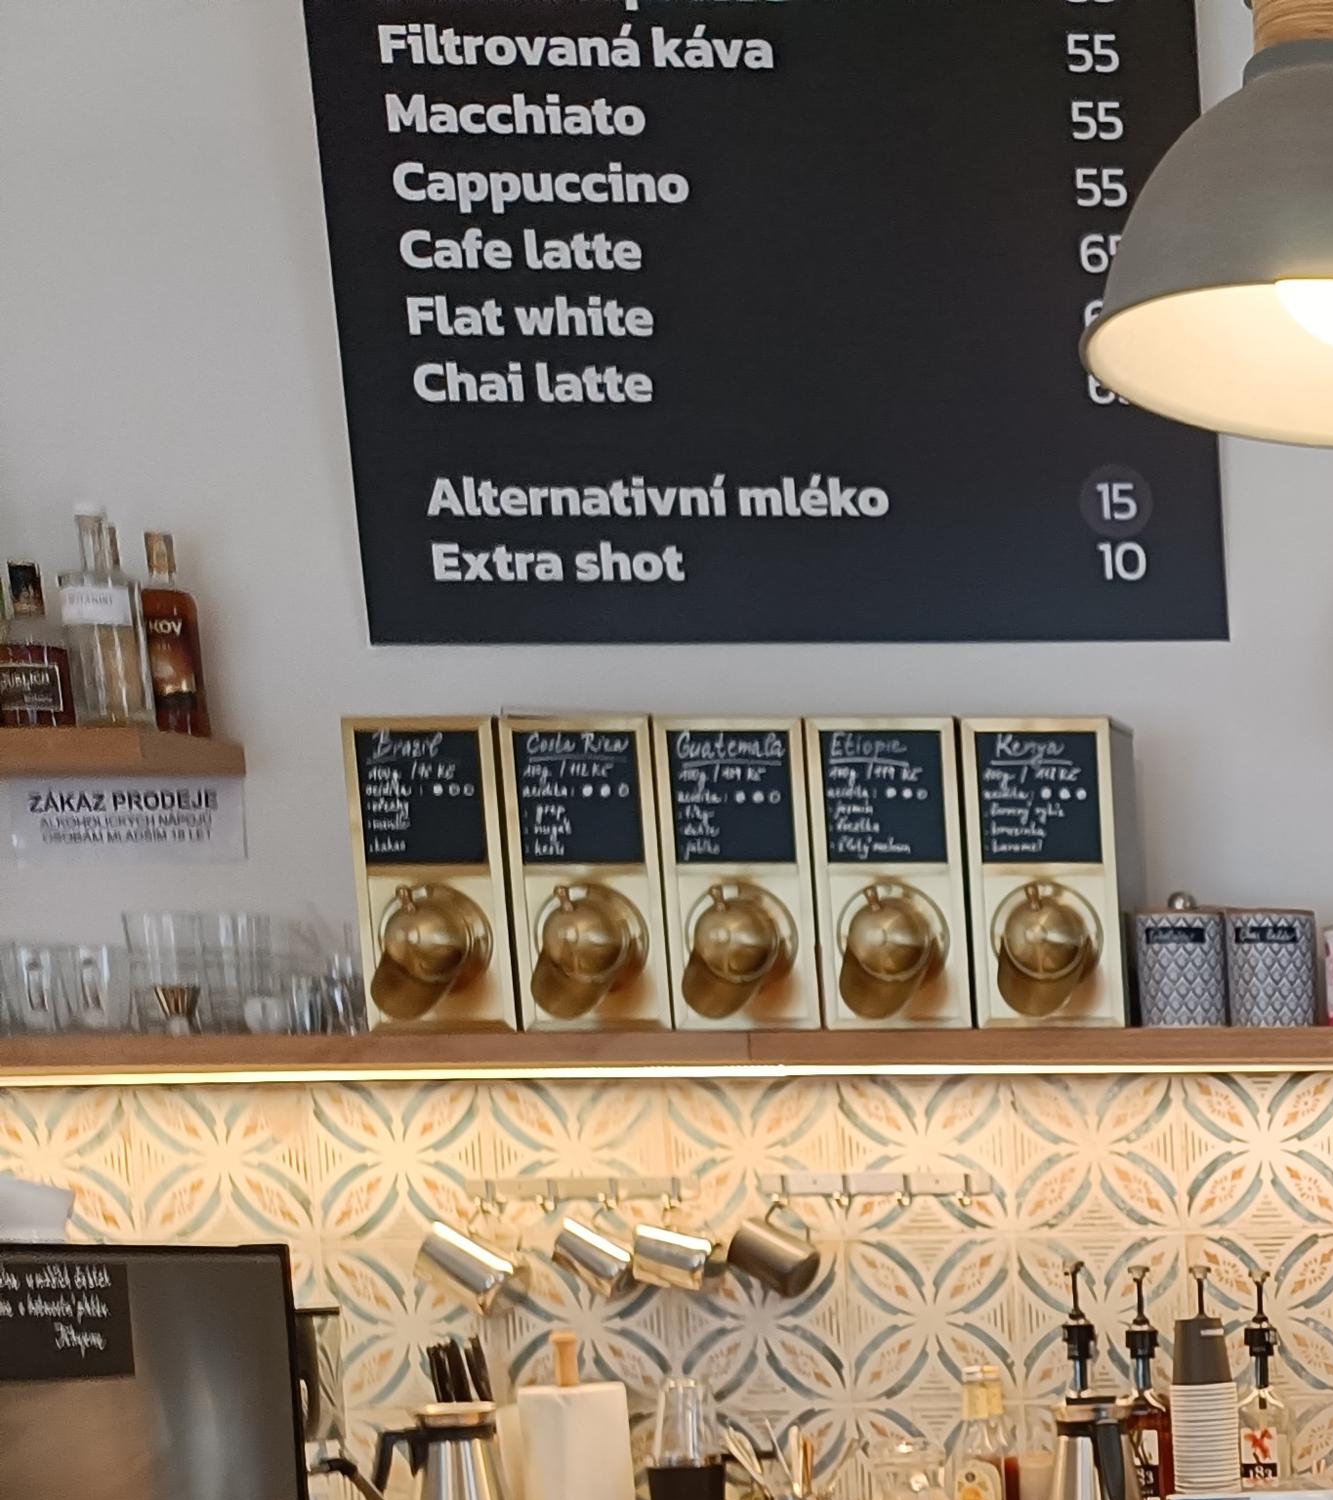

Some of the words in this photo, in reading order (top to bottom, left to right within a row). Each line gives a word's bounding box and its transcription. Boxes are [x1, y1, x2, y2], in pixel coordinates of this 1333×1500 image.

[377, 23, 641, 67] Filtrovaná
[650, 24, 774, 69] káva
[1066, 33, 1120, 73] 55
[384, 92, 646, 136] Macchiato
[1071, 101, 1124, 141] 55
[392, 161, 690, 214] Cappuccino
[1075, 168, 1128, 207] 55
[399, 227, 513, 269] Cafe
[523, 228, 642, 270] latte
[406, 295, 505, 336] Flat
[514, 295, 655, 337] white
[412, 361, 525, 403] Chai
[534, 361, 653, 403] latte
[427, 473, 727, 517] Alternativní
[738, 473, 890, 518] mléko
[1096, 482, 1138, 521] 15
[431, 541, 564, 582] Extra
[575, 541, 686, 583] shot
[1096, 541, 1147, 581] 10
[371, 729, 443, 760] Brazil
[526, 733, 576, 754] Costa
[581, 732, 630, 754] Rica
[675, 731, 786, 760] Guatemala
[830, 732, 907, 760] Etiopie
[995, 733, 1065, 767] Kenya
[28, 787, 107, 814] ZÁKAZ
[111, 788, 219, 812] PRODEJE
